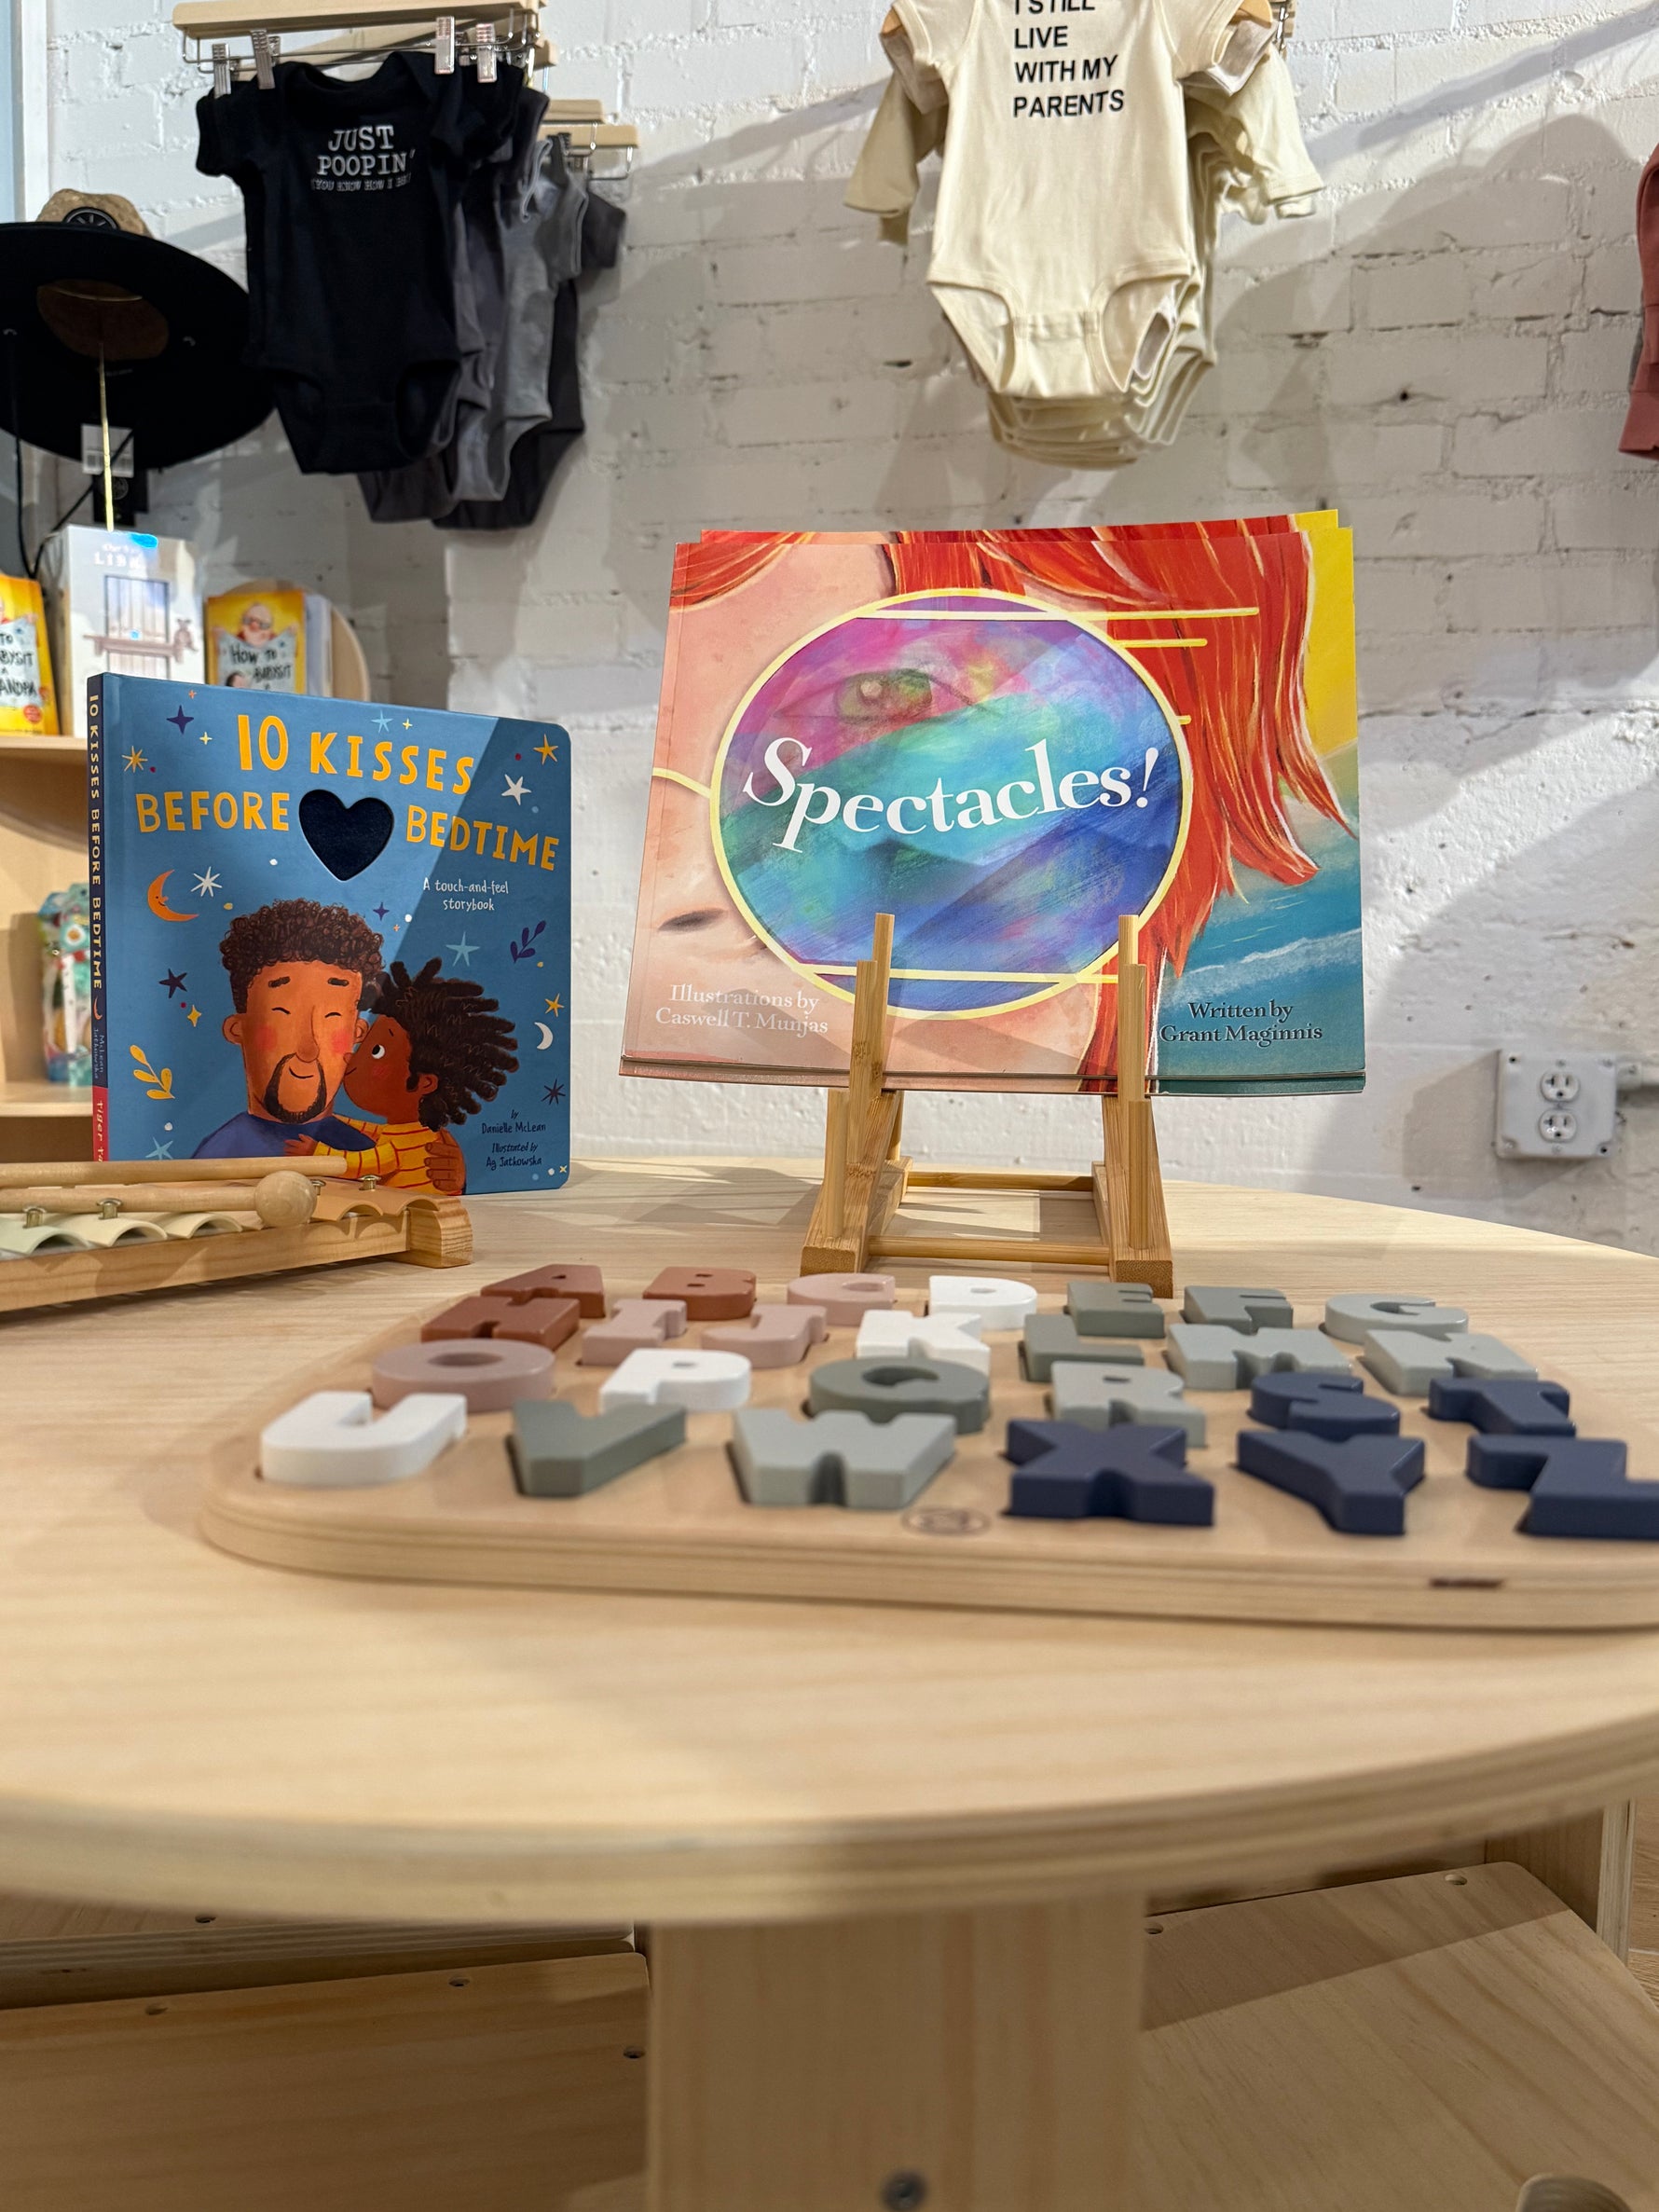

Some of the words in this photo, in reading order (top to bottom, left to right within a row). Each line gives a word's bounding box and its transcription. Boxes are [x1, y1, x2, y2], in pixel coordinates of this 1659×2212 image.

[1014, 25, 1068, 48] LIVE
[1014, 60, 1076, 83] WITH
[1082, 54, 1118, 81] MY
[1013, 89, 1124, 117] PARENTS
[328, 124, 394, 151] JUST
[317, 149, 416, 176] POOPIN'
[0, 650, 34, 666] BYSIT
[89, 694, 99, 717] 10
[89, 725, 100, 799] KISSES
[238, 714, 289, 771] 10
[309, 732, 474, 795] KISSES
[743, 736, 1159, 853] Spectacles!
[135, 790, 290, 832] BEFORE
[406, 804, 559, 871] BEDTIME
[90, 809, 101, 886] BEFORE
[423, 877, 431, 891] A
[434, 878, 509, 895] touch-and-feel
[443, 898, 495, 912] storybook
[92, 897, 103, 989] BEDTIME
[670, 983, 792, 1009] Illustrations
[797, 990, 819, 1014] by
[1188, 1001, 1266, 1019] Written
[1269, 998, 1294, 1024] by
[655, 1007, 730, 1027] Caswell
[734, 1010, 750, 1028] T.
[756, 1013, 829, 1037] Munjas
[1159, 1025, 1222, 1042] Grant
[1225, 1023, 1323, 1048] Maginnis
[482, 1121, 513, 1133] Danielle
[515, 1121, 546, 1133] McLean
[511, 1109, 519, 1120] by
[492, 1142, 529, 1153] Illustrated
[530, 1142, 538, 1153] by
[486, 1156, 497, 1171] Ag
[500, 1155, 542, 1167] Jatkowska
[481, 1264, 606, 1318] A
[642, 1266, 757, 1320] B
[788, 1272, 896, 1326] C
[929, 1275, 1037, 1330] D
[1067, 1282, 1165, 1338] E
[1184, 1285, 1294, 1334] F
[1324, 1293, 1468, 1344] G
[421, 1296, 580, 1350] H
[701, 1304, 828, 1368] J
[856, 1310, 990, 1377] K
[1024, 1313, 1144, 1382] L
[1167, 1324, 1352, 1390] M
[1364, 1329, 1538, 1398] N
[600, 1348, 751, 1411] P
[1052, 1361, 1206, 1448] R
[1251, 1372, 1400, 1440] S
[1428, 1377, 1576, 1438] T
[260, 1391, 466, 1487] U
[511, 1400, 688, 1498] V
[734, 1408, 956, 1510] W
[1006, 1418, 1215, 1527] X
[1236, 1430, 1425, 1536] Y
[1465, 1433, 1659, 1540] Z
